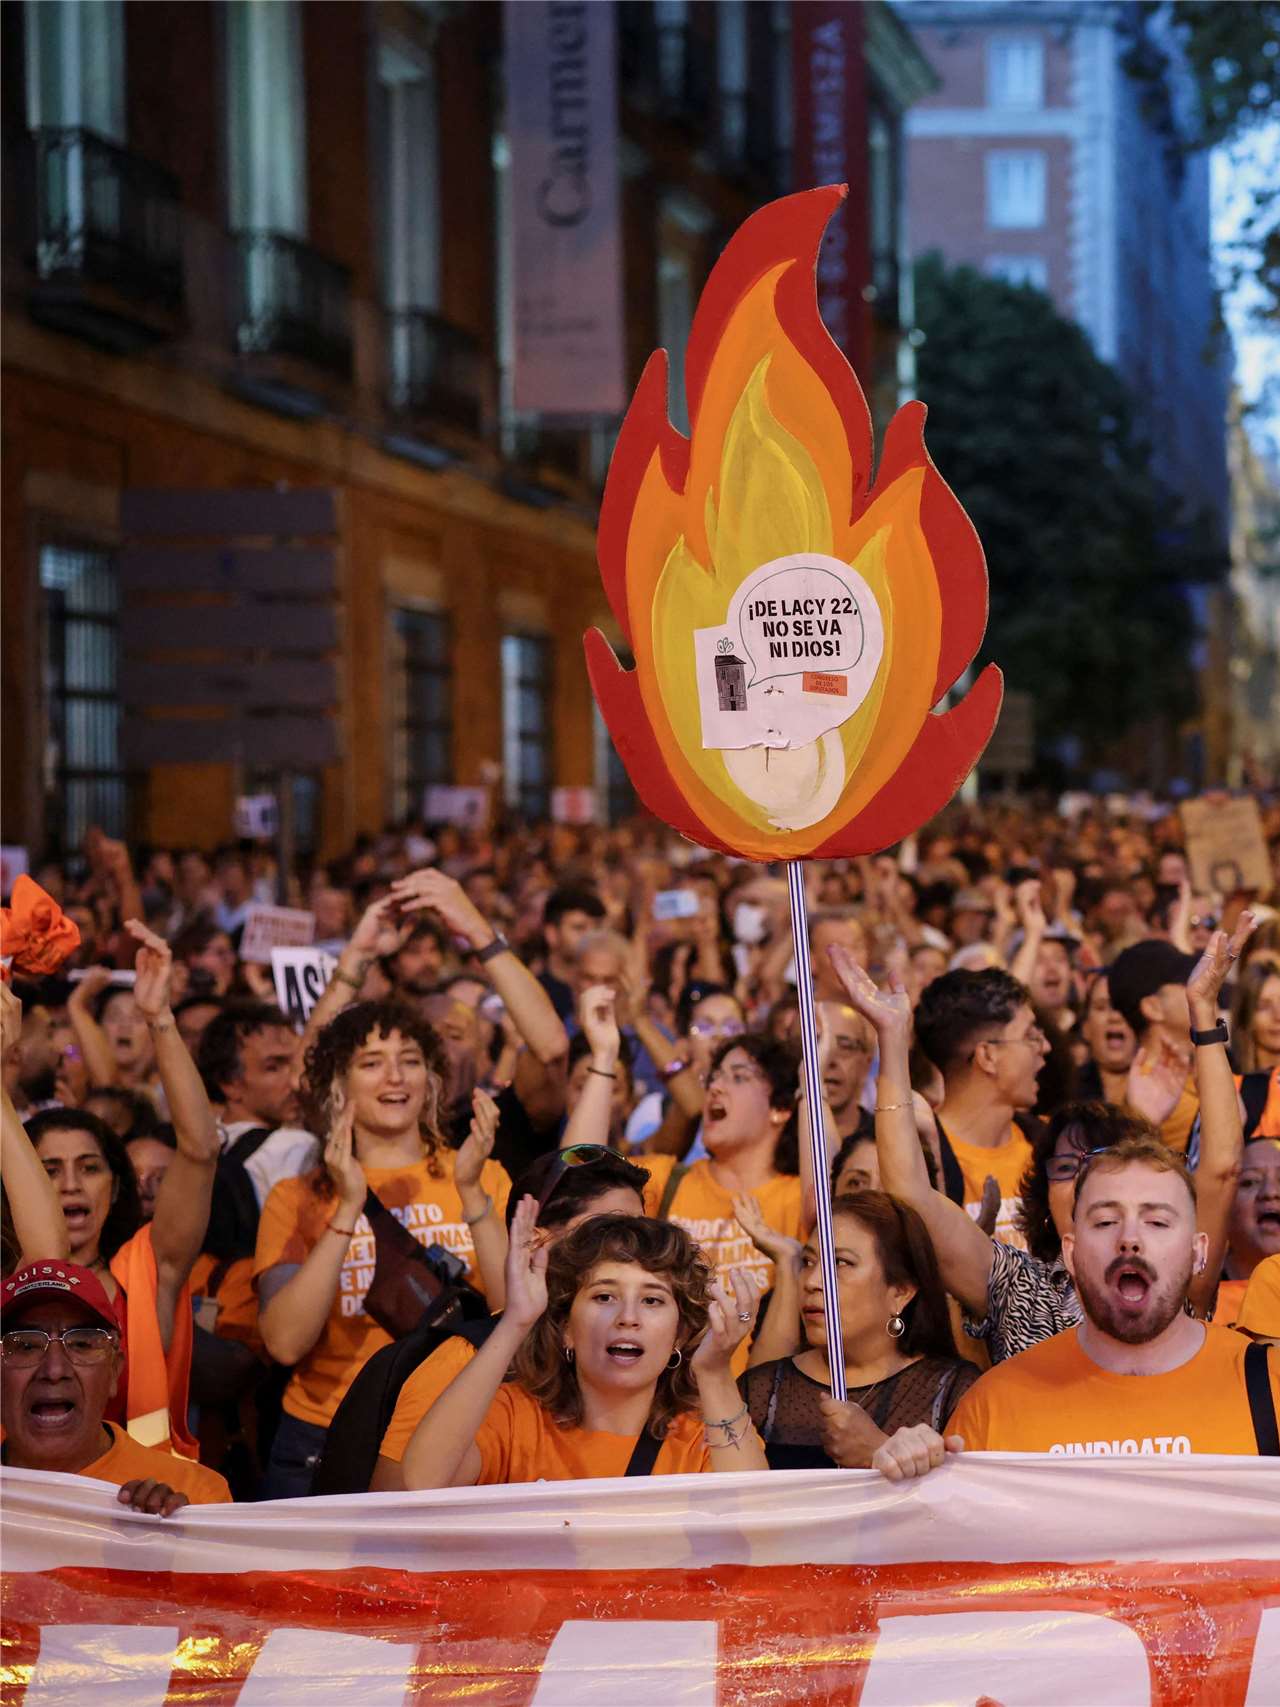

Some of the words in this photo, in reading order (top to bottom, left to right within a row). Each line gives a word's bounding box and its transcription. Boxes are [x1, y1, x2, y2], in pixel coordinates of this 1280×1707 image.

[748, 600, 778, 620] ¡DE
[781, 598, 827, 617] LACY
[830, 597, 859, 616] 22,
[763, 620, 789, 637] NO
[792, 619, 814, 637] SE
[816, 619, 842, 636] VA
[769, 641, 789, 658] NI
[792, 640, 841, 658] DIOS!
